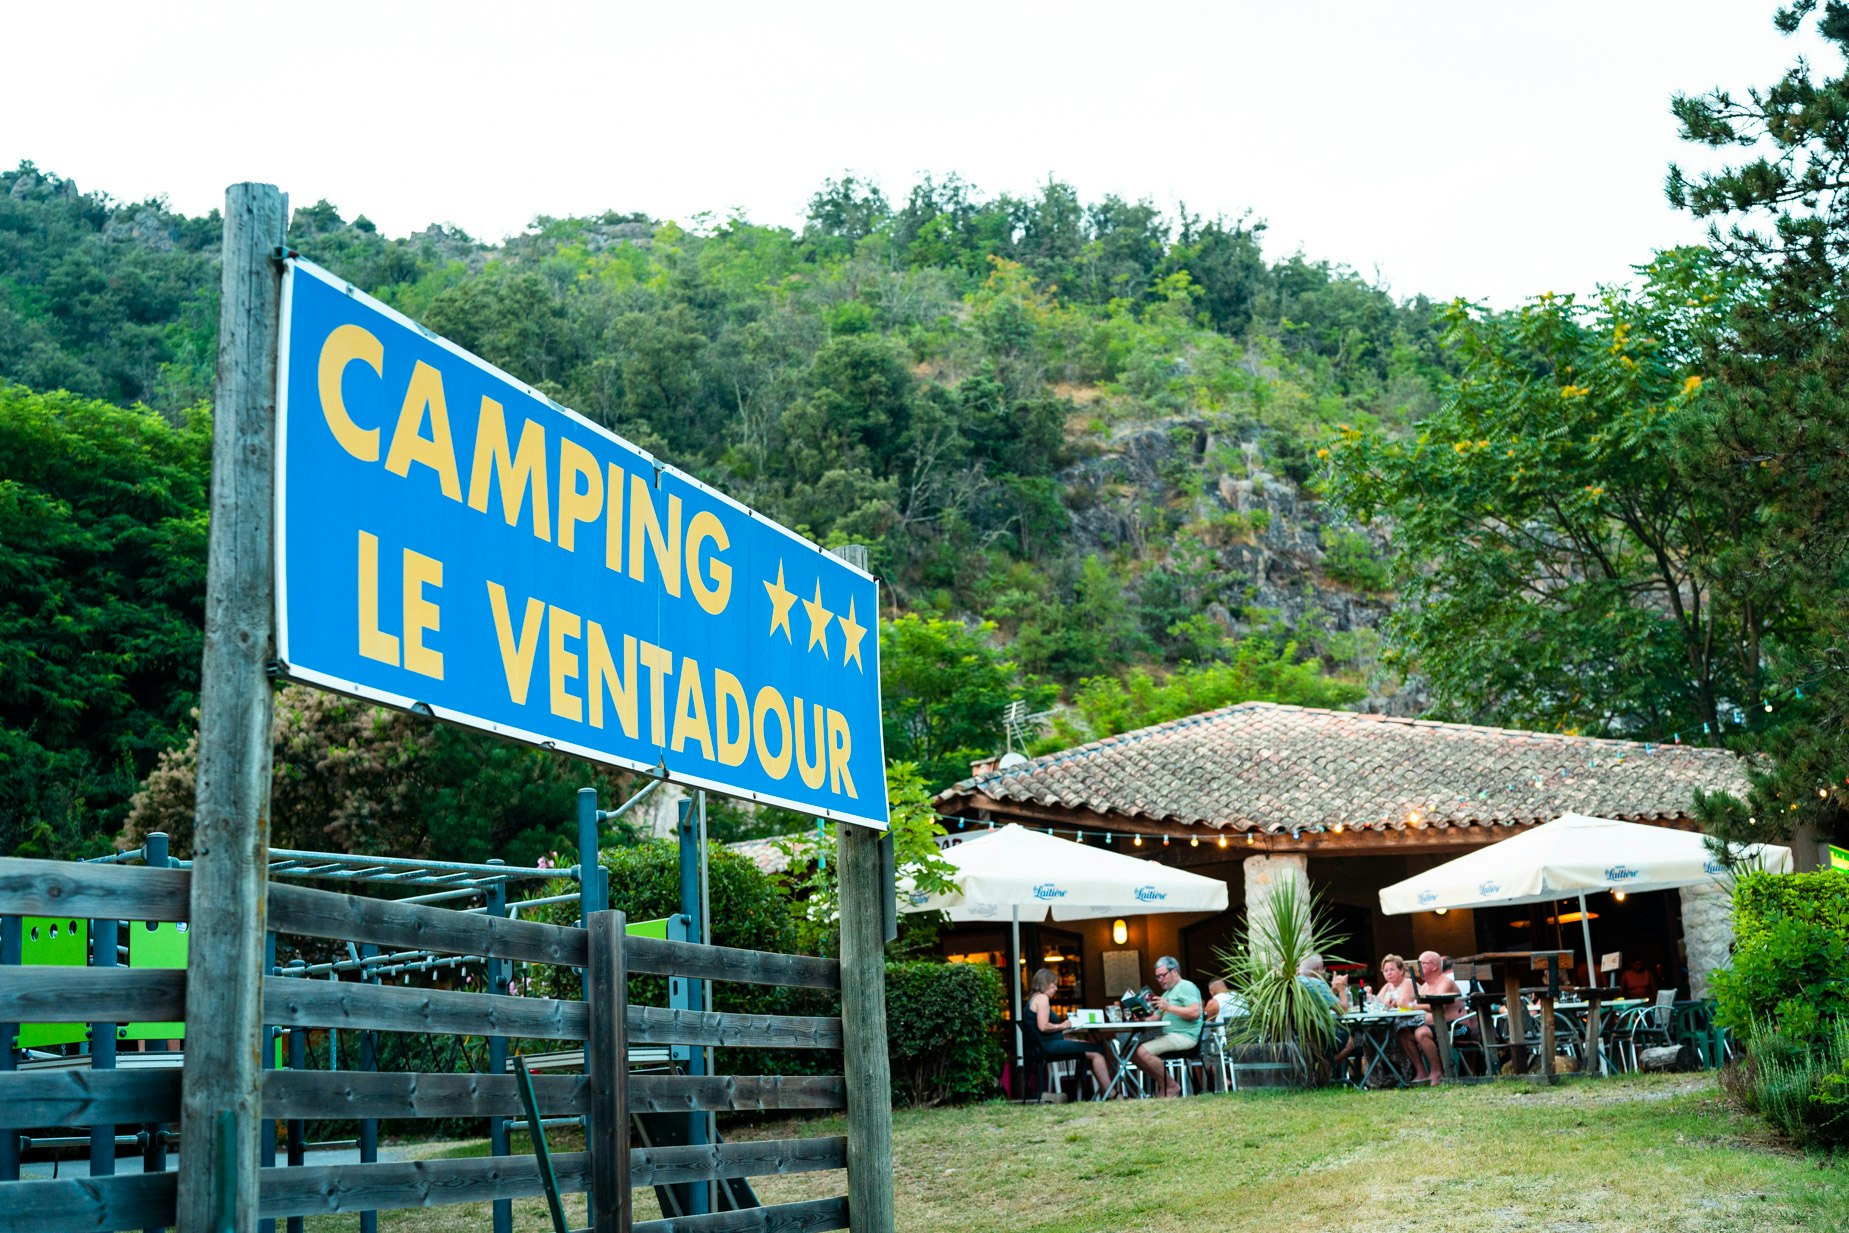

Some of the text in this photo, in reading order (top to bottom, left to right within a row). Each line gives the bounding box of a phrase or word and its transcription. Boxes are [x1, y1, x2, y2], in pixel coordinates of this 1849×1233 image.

[318, 324, 732, 615] CAMPING
[359, 530, 857, 798] LE VENTADOUR
